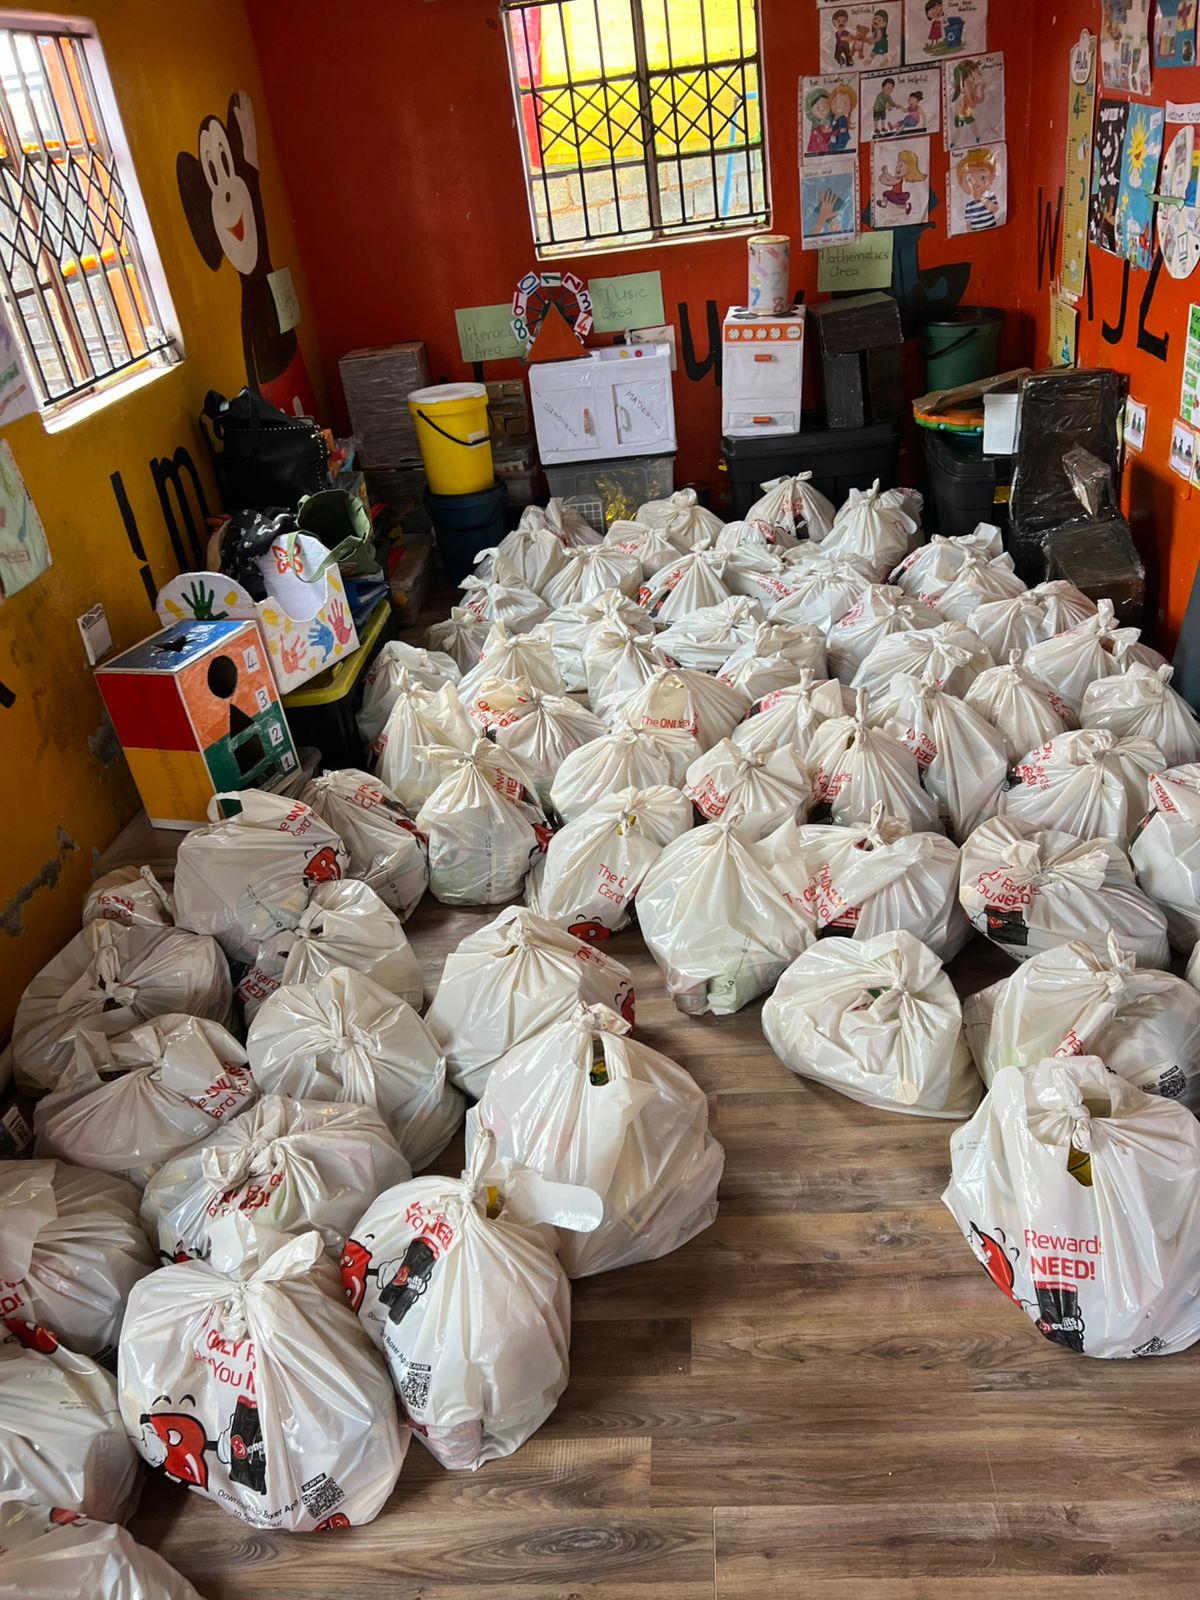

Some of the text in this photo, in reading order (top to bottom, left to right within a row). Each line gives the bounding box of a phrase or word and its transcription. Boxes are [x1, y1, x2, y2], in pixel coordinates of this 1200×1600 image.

[820, 249, 890, 265] Mathematics
[579, 293, 591, 310] 3
[596, 282, 649, 302] Music
[514, 318, 528, 339] 8
[246, 651, 258, 669] 4
[257, 690, 268, 709] 3
[641, 715, 660, 727] The
[271, 727, 282, 742] 2
[283, 756, 293, 769] 1
[598, 863, 618, 885] The
[598, 883, 625, 904] Card
[1030, 1256, 1096, 1281] NEED!
[385, 1335, 401, 1357] Boxer
[211, 1358, 244, 1388] YOU
